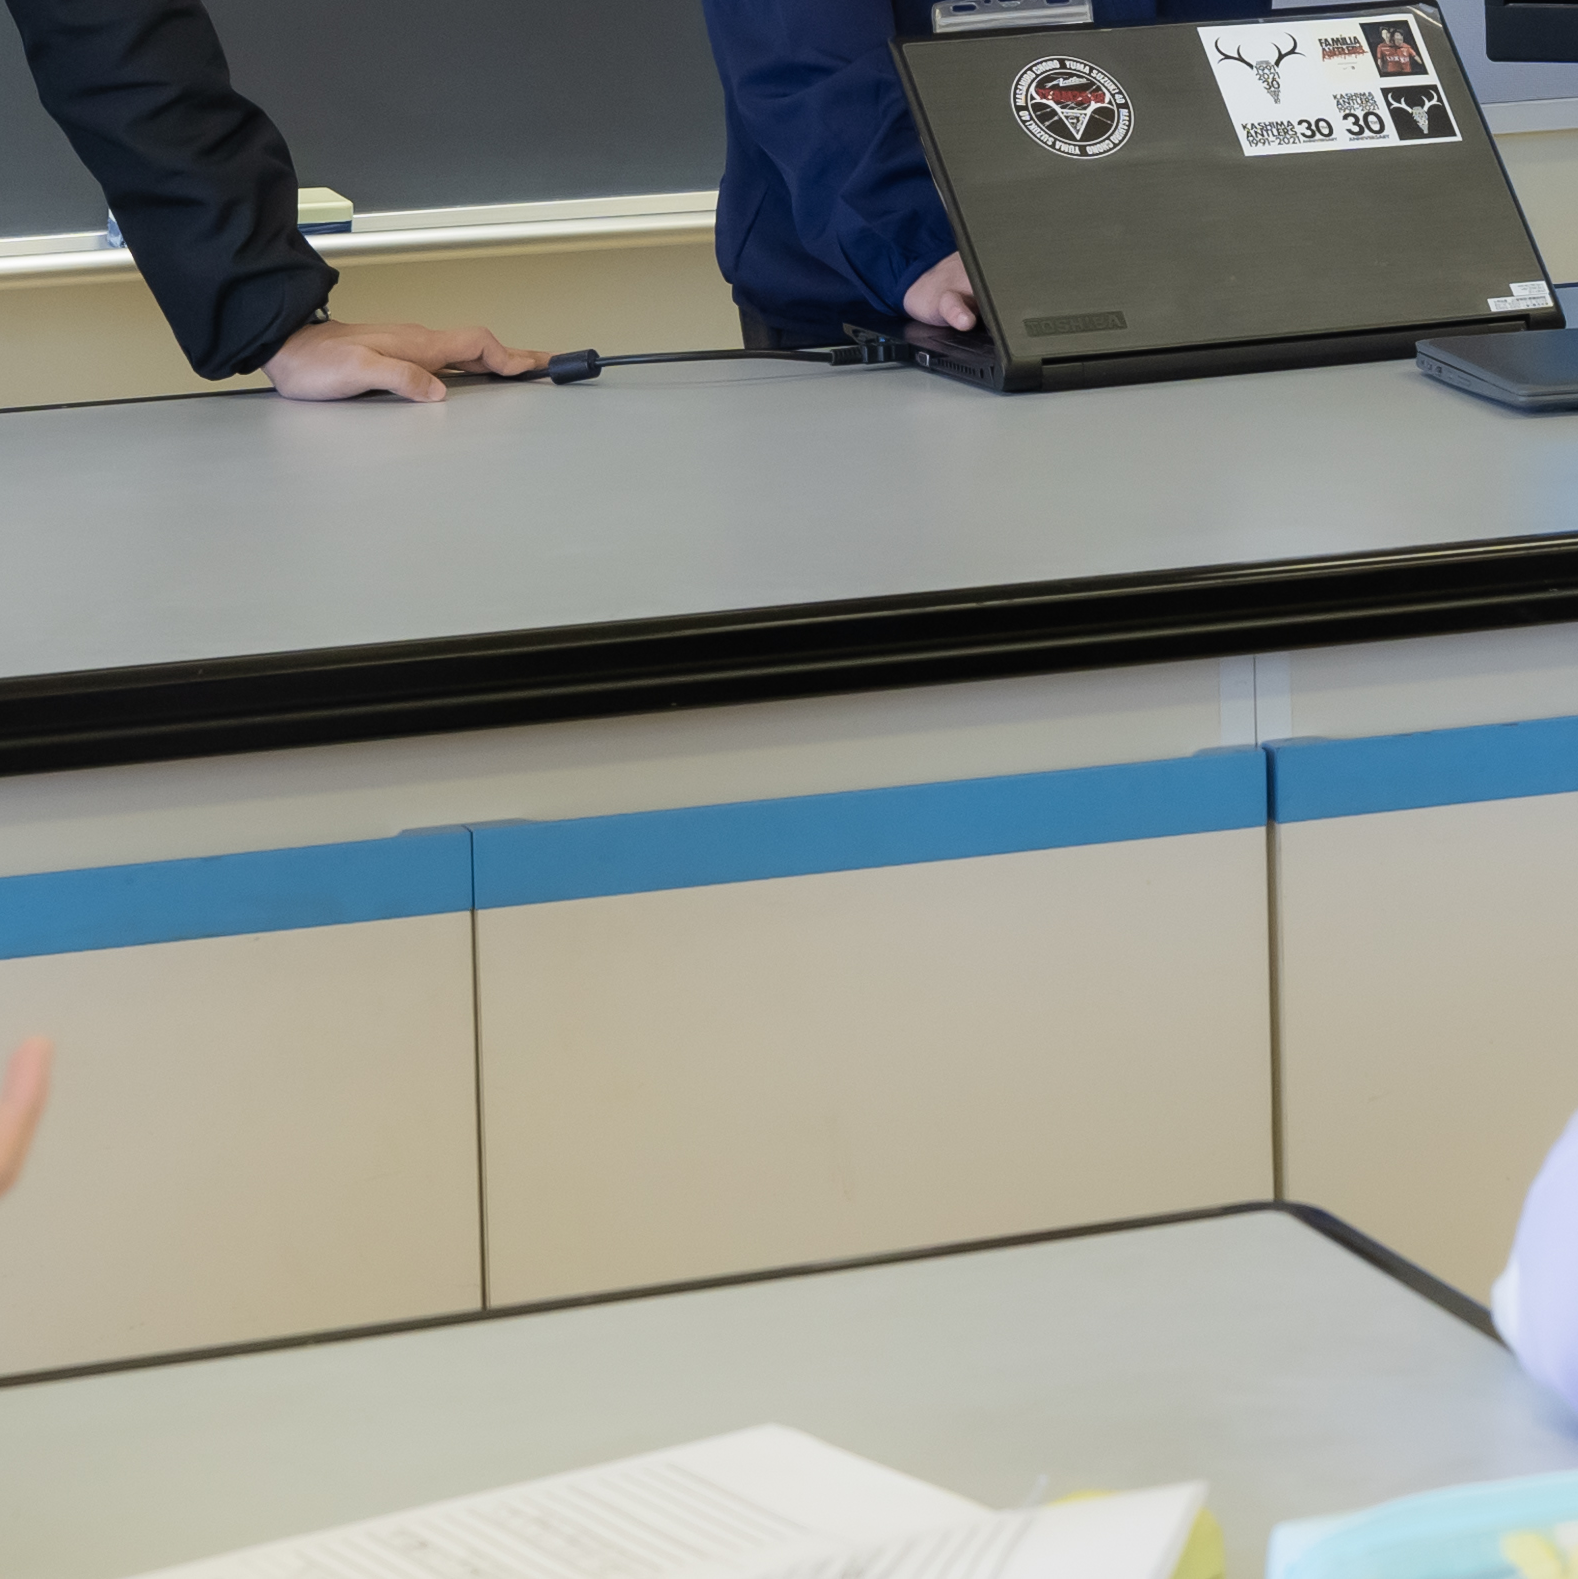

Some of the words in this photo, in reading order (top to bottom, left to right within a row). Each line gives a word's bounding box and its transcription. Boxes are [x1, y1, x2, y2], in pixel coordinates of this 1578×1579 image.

[1064, 60, 1090, 74] YUMA
[1090, 69, 1120, 94] SUZUKI
[1115, 93, 1126, 104] 40
[1262, 79, 1281, 90] 30
[1332, 91, 1375, 101] KASHIMA
[1335, 98, 1378, 108] ANTLERS
[1241, 120, 1296, 132] KASHIMA
[1297, 117, 1334, 139] 30
[1342, 111, 1386, 136] 30
[1025, 121, 1055, 146] SUZUKI
[1246, 128, 1298, 140] ANTLERS
[1054, 141, 1081, 155] YUMA
[1247, 136, 1302, 148] 1991-2021
